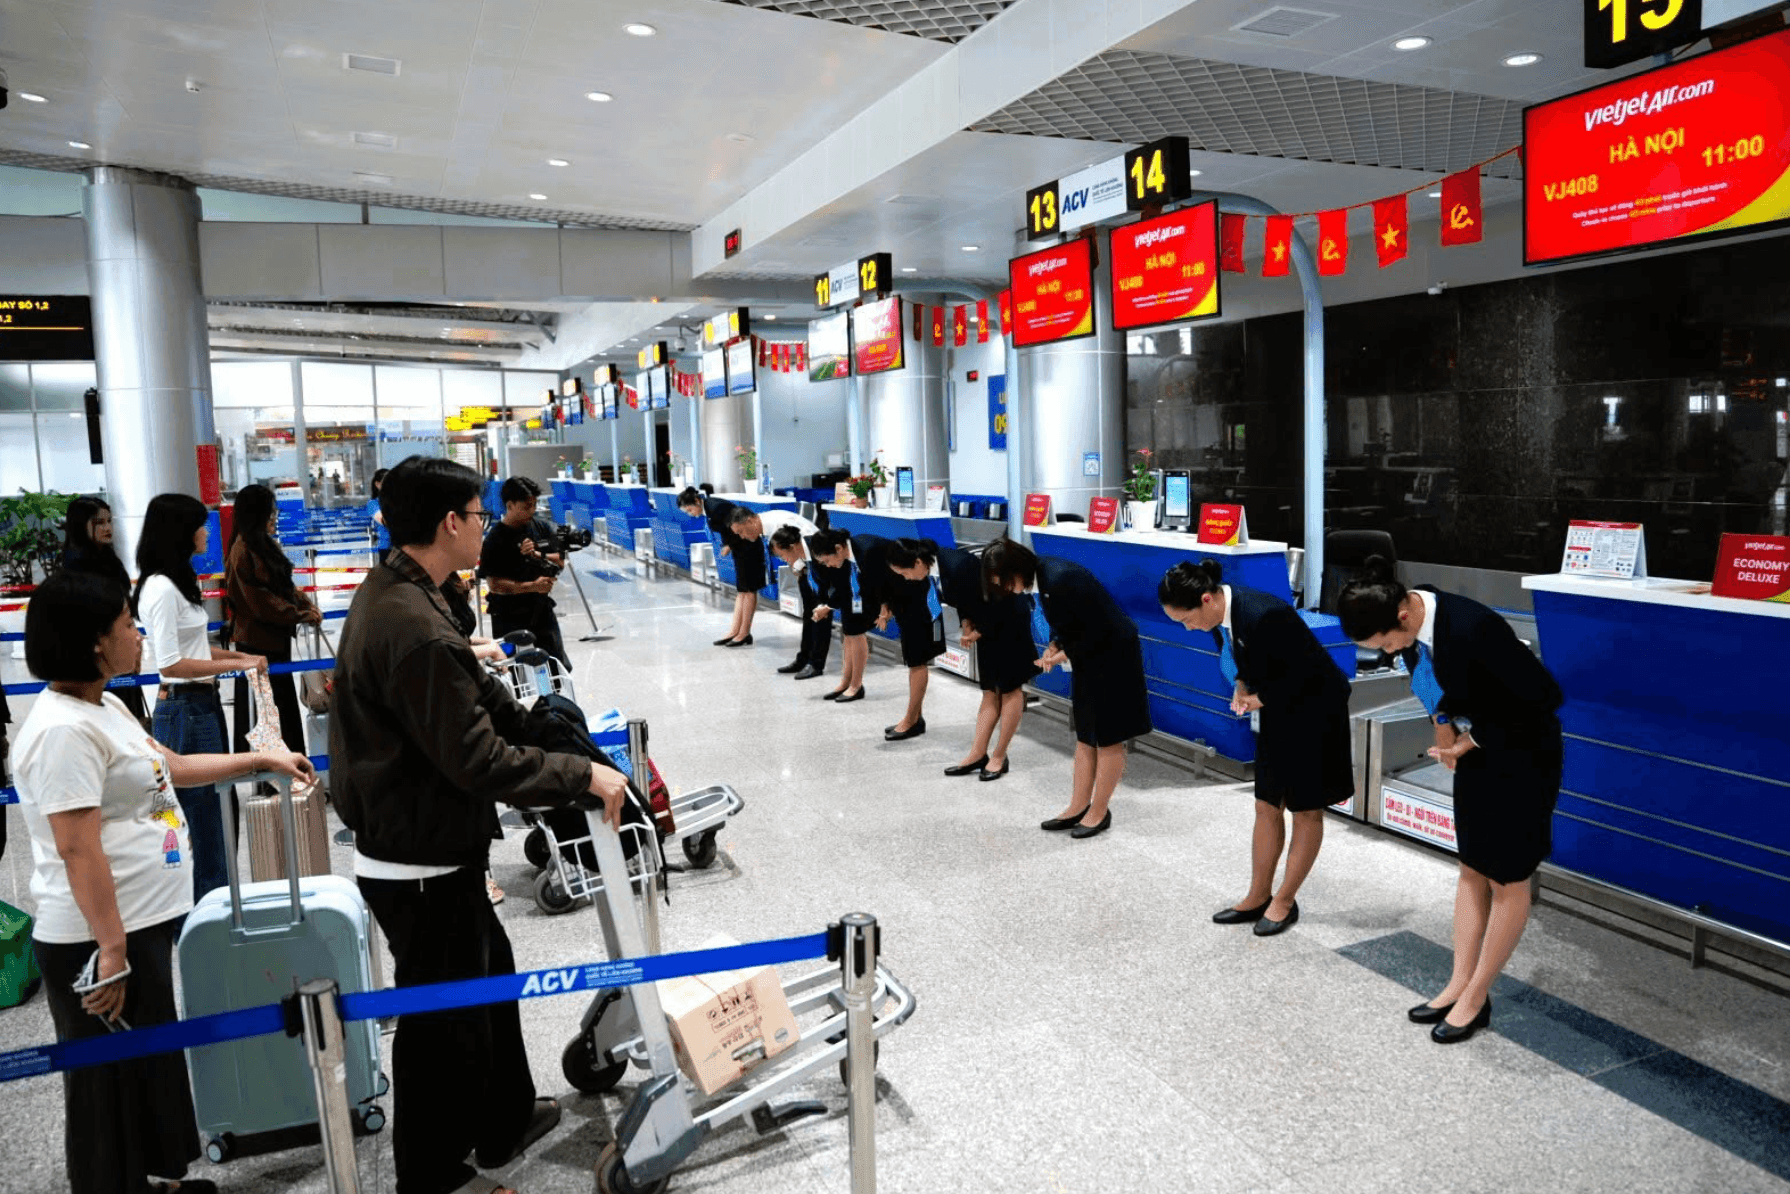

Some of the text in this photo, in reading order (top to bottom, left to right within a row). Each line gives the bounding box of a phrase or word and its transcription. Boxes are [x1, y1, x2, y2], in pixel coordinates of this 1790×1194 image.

[1609, 127, 1686, 164] HÀ NỘI
[1702, 135, 1765, 168] 11:00
[1131, 149, 1166, 199] 14
[1543, 174, 1599, 202] VJ408
[1030, 190, 1057, 232] 13
[1061, 187, 1090, 215] ACV
[861, 260, 877, 291] 12
[18, 299, 33, 310] SỐ
[816, 277, 829, 305] 11
[1733, 558, 1790, 571] ECONOMY
[1737, 571, 1780, 584] DELUXE
[521, 968, 579, 996] ACV
